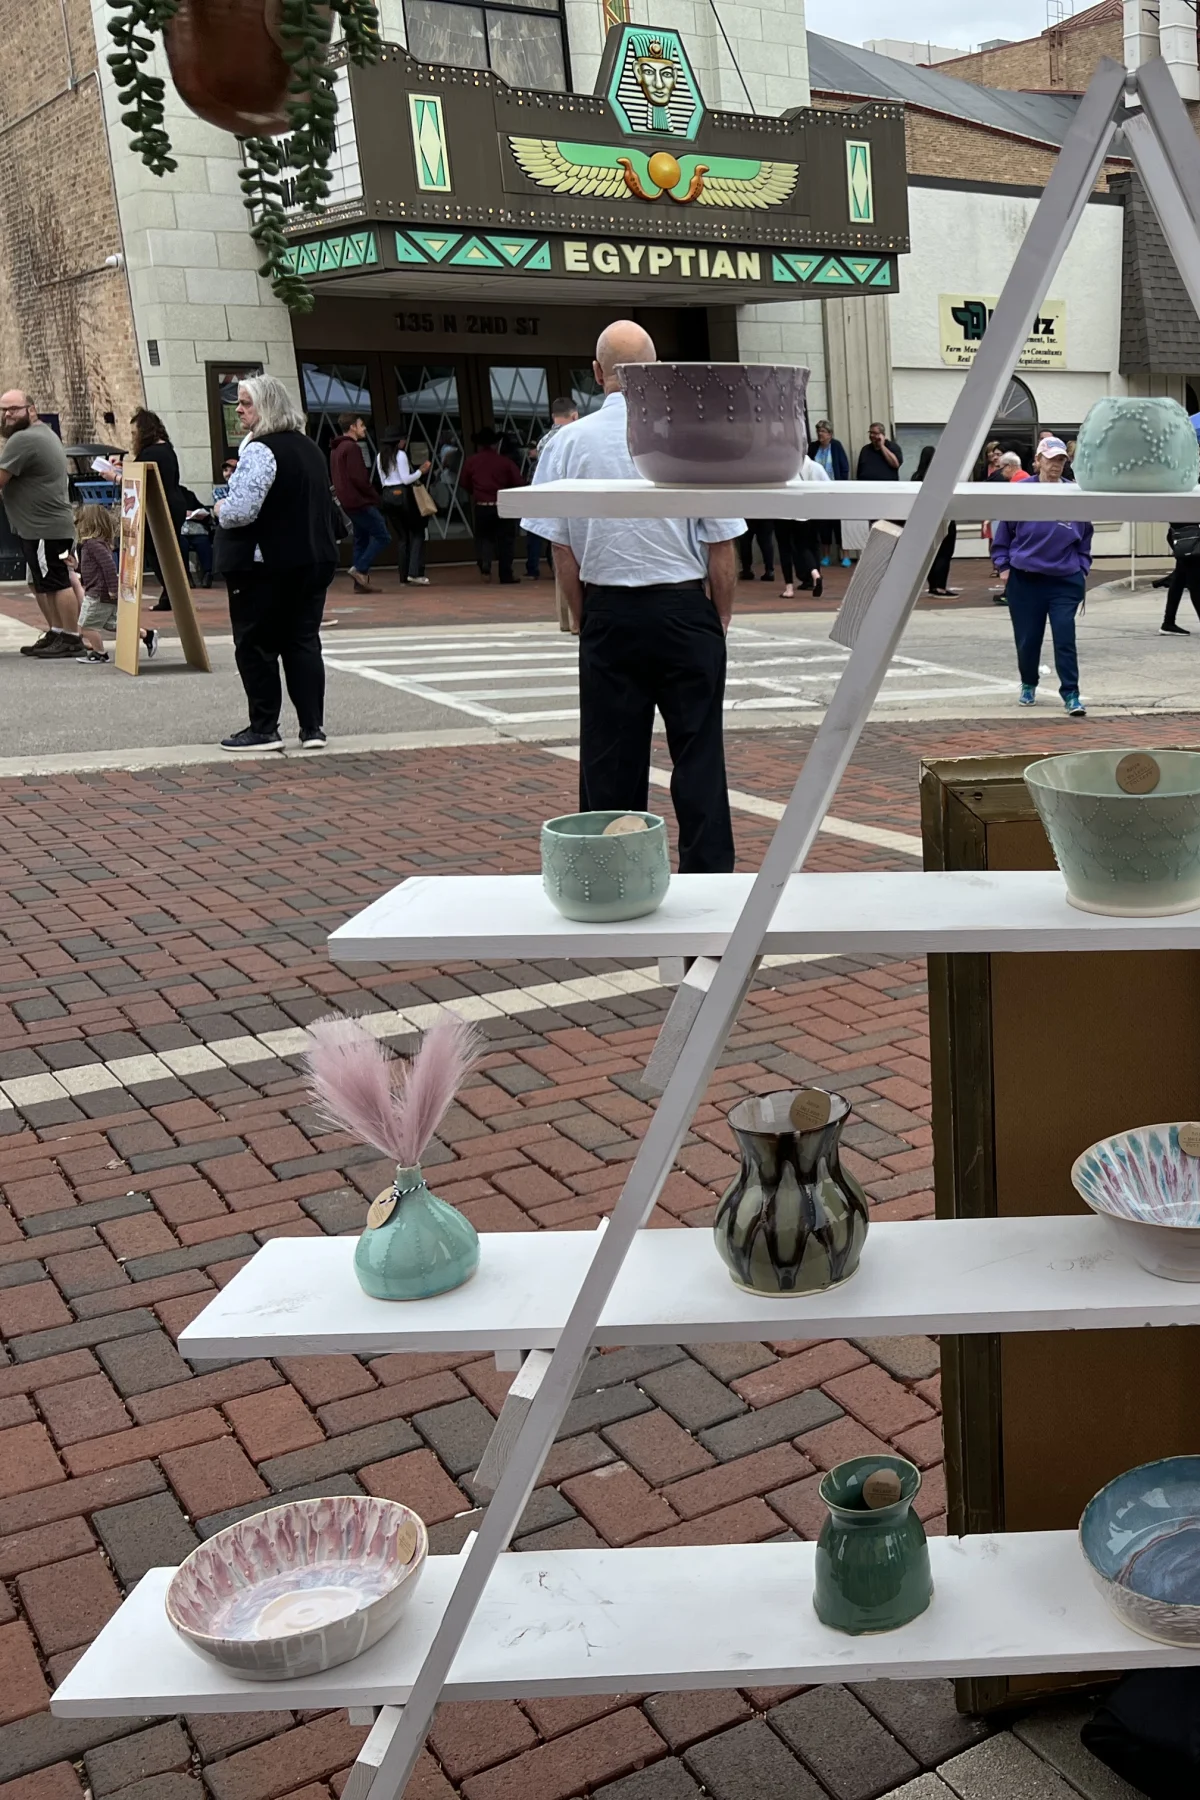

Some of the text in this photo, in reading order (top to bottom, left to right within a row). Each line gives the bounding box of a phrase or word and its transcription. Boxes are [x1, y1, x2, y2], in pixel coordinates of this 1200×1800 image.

[563, 241, 761, 280] EGYPTIAN
[394, 312, 541, 336] 135 N 2ND ST
[945, 344, 962, 353] Farm
[1030, 348, 1063, 356] Consultants
